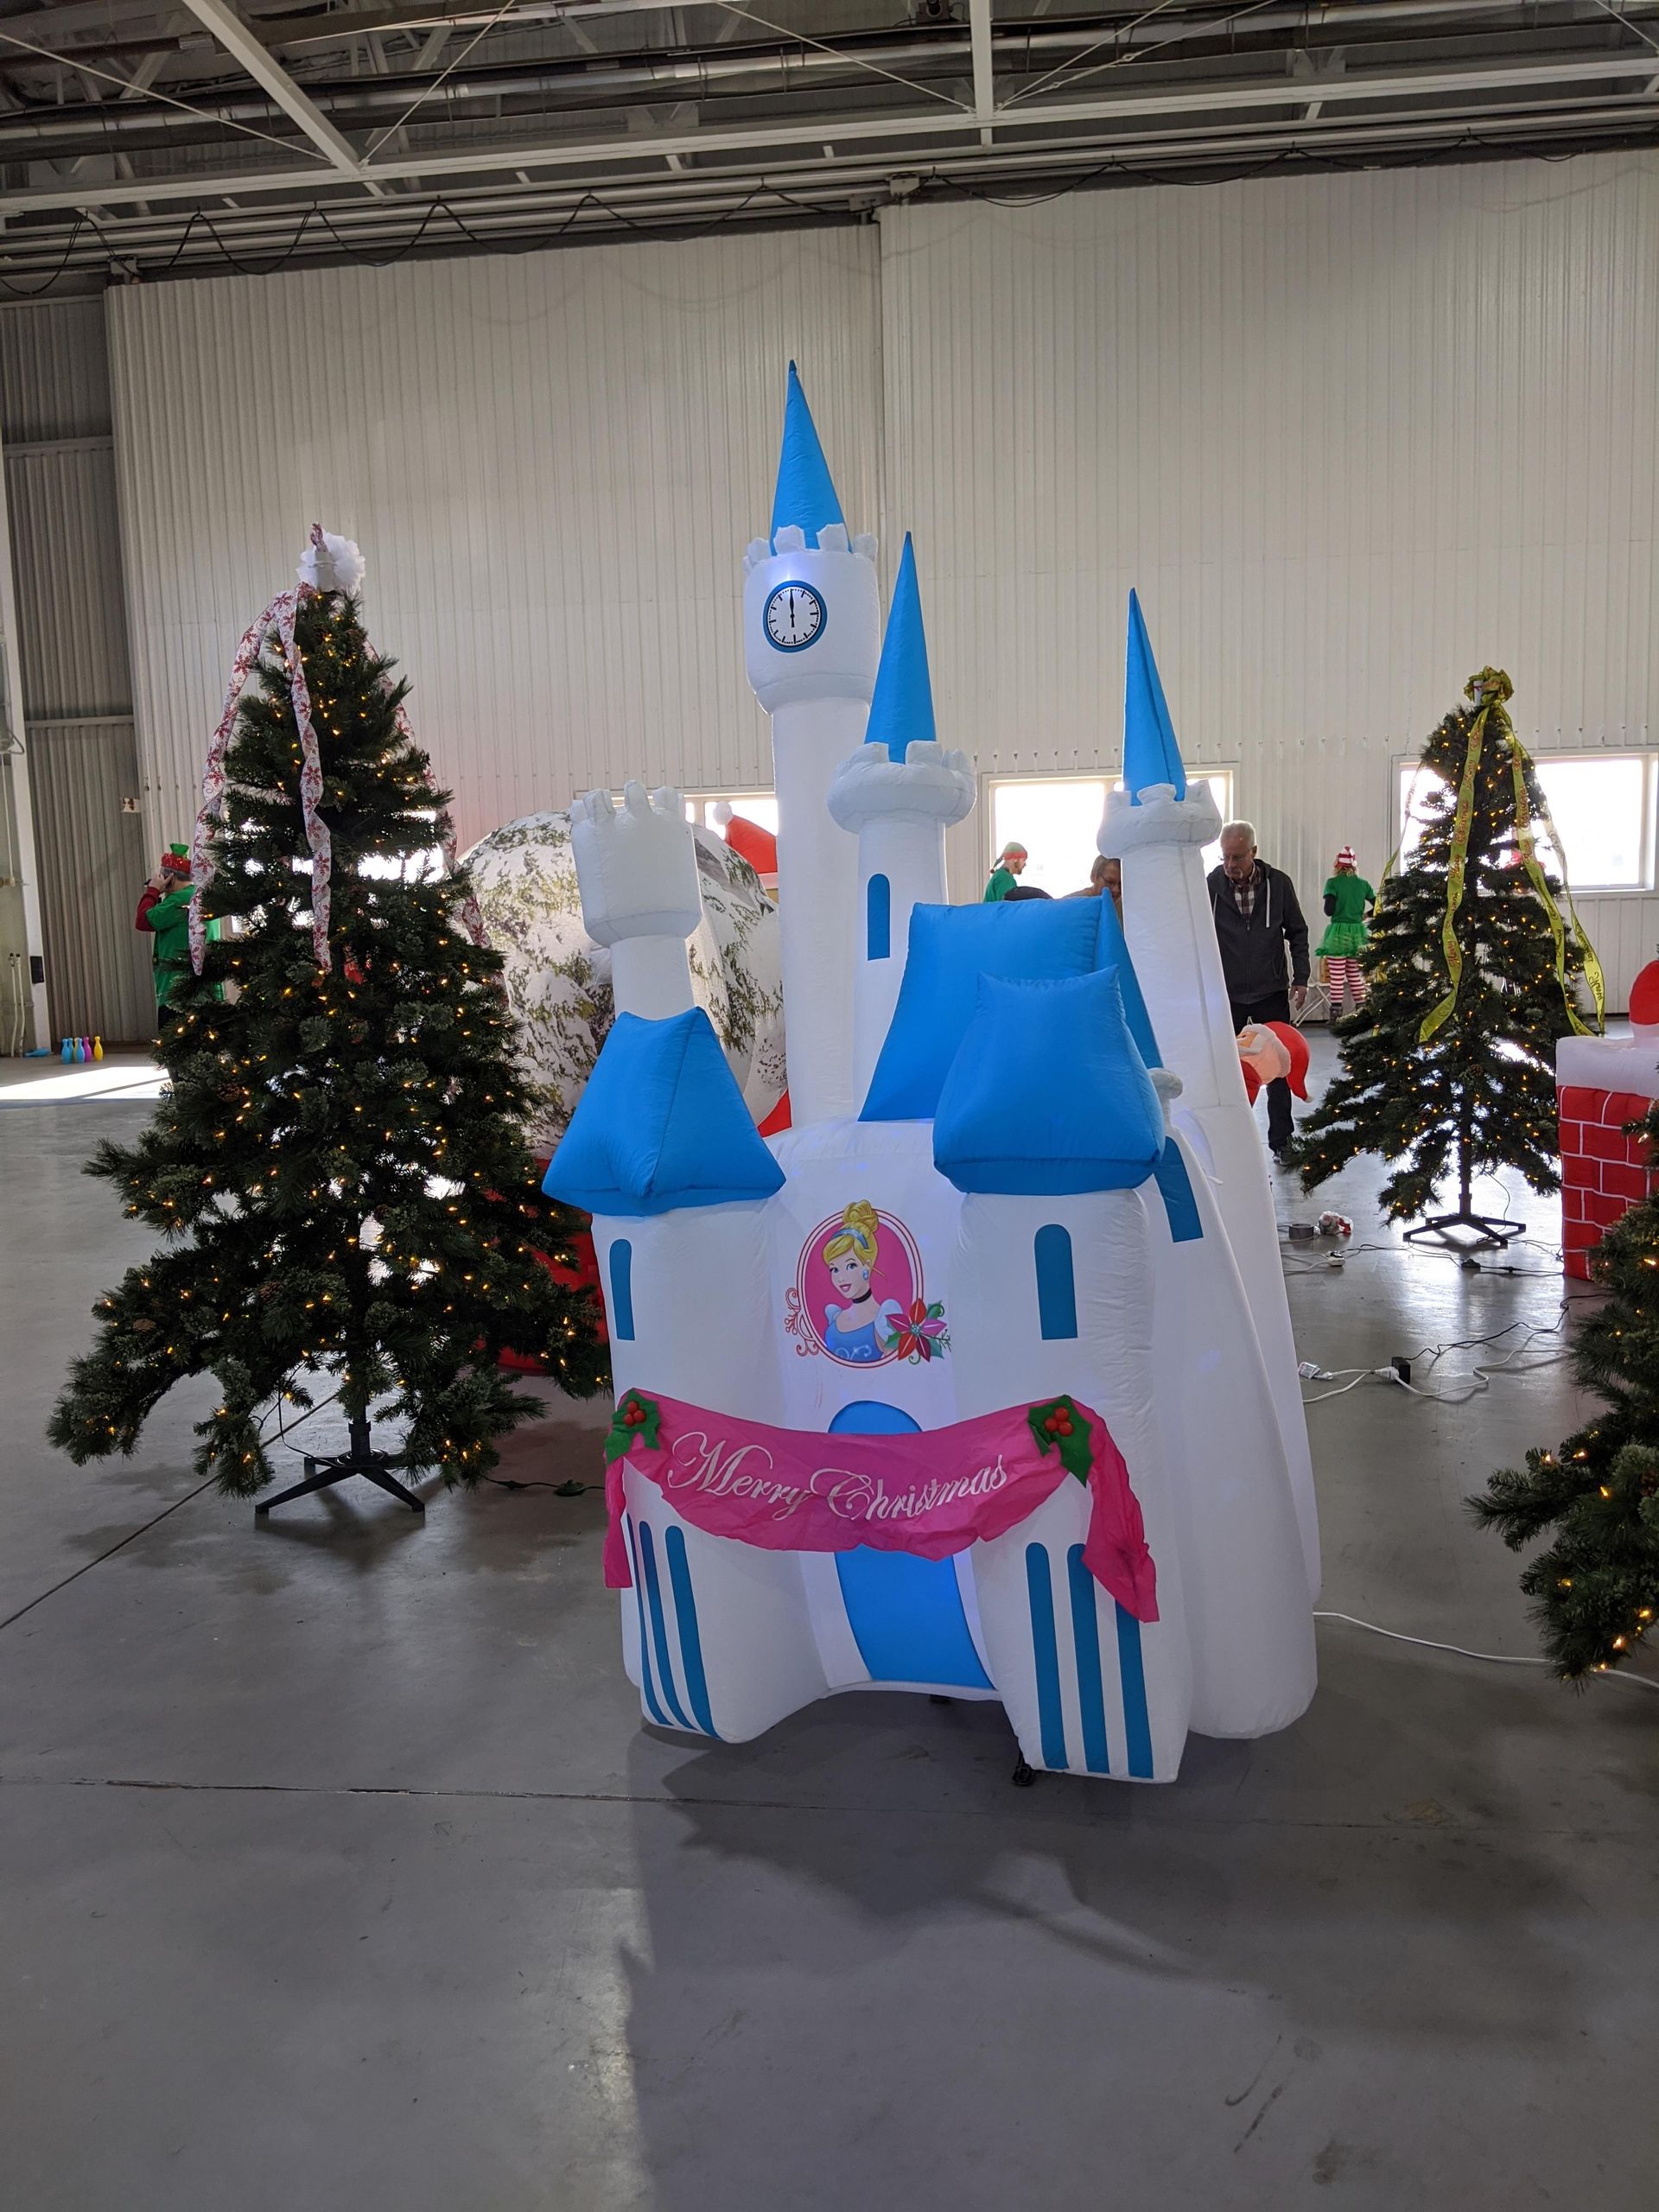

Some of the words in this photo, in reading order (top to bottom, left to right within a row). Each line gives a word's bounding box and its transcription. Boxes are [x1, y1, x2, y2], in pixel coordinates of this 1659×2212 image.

[1446, 940, 1460, 969] Merry
[667, 1431, 814, 1521] Merry
[809, 1453, 1008, 1521] Christmas
